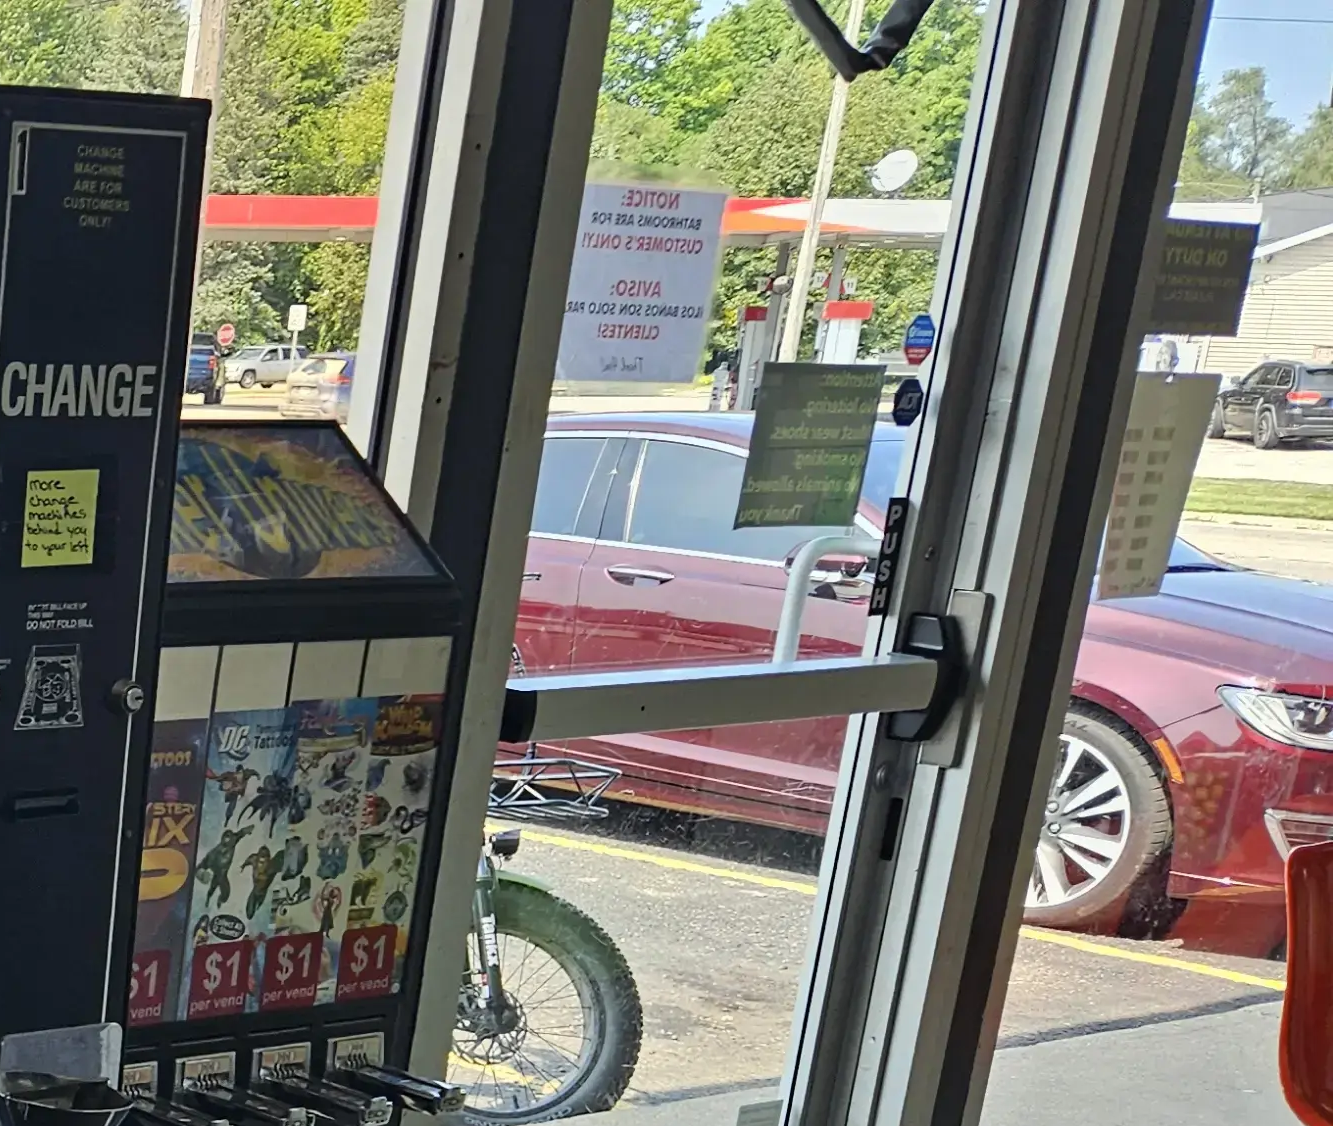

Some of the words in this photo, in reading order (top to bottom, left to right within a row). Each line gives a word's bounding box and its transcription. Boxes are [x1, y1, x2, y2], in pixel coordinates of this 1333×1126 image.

[77, 145, 125, 159] CHANGE
[74, 163, 124, 177] MACHINE
[73, 180, 97, 193] ARE
[100, 182, 122, 194] FOR
[63, 197, 130, 212] CUSTOMERS
[1, 361, 157, 417] CHANGE
[29, 479, 65, 491] more
[30, 495, 79, 509] change
[67, 527, 87, 538] you
[25, 541, 38, 551] to
[41, 543, 66, 556] your
[874, 505, 901, 610] PUSH
[26, 620, 38, 630] DO
[39, 620, 56, 629] NOT
[57, 619, 77, 629] FOLD
[153, 803, 196, 815] STERY
[350, 934, 387, 977] $1
[275, 943, 312, 985] $1
[203, 950, 241, 995] $1
[263, 990, 283, 1004] per
[285, 985, 315, 999] vend
[338, 983, 358, 996] per
[360, 978, 389, 991] vend
[130, 1004, 161, 1018] vend
[190, 1000, 210, 1015] per
[213, 993, 244, 1008] vend
